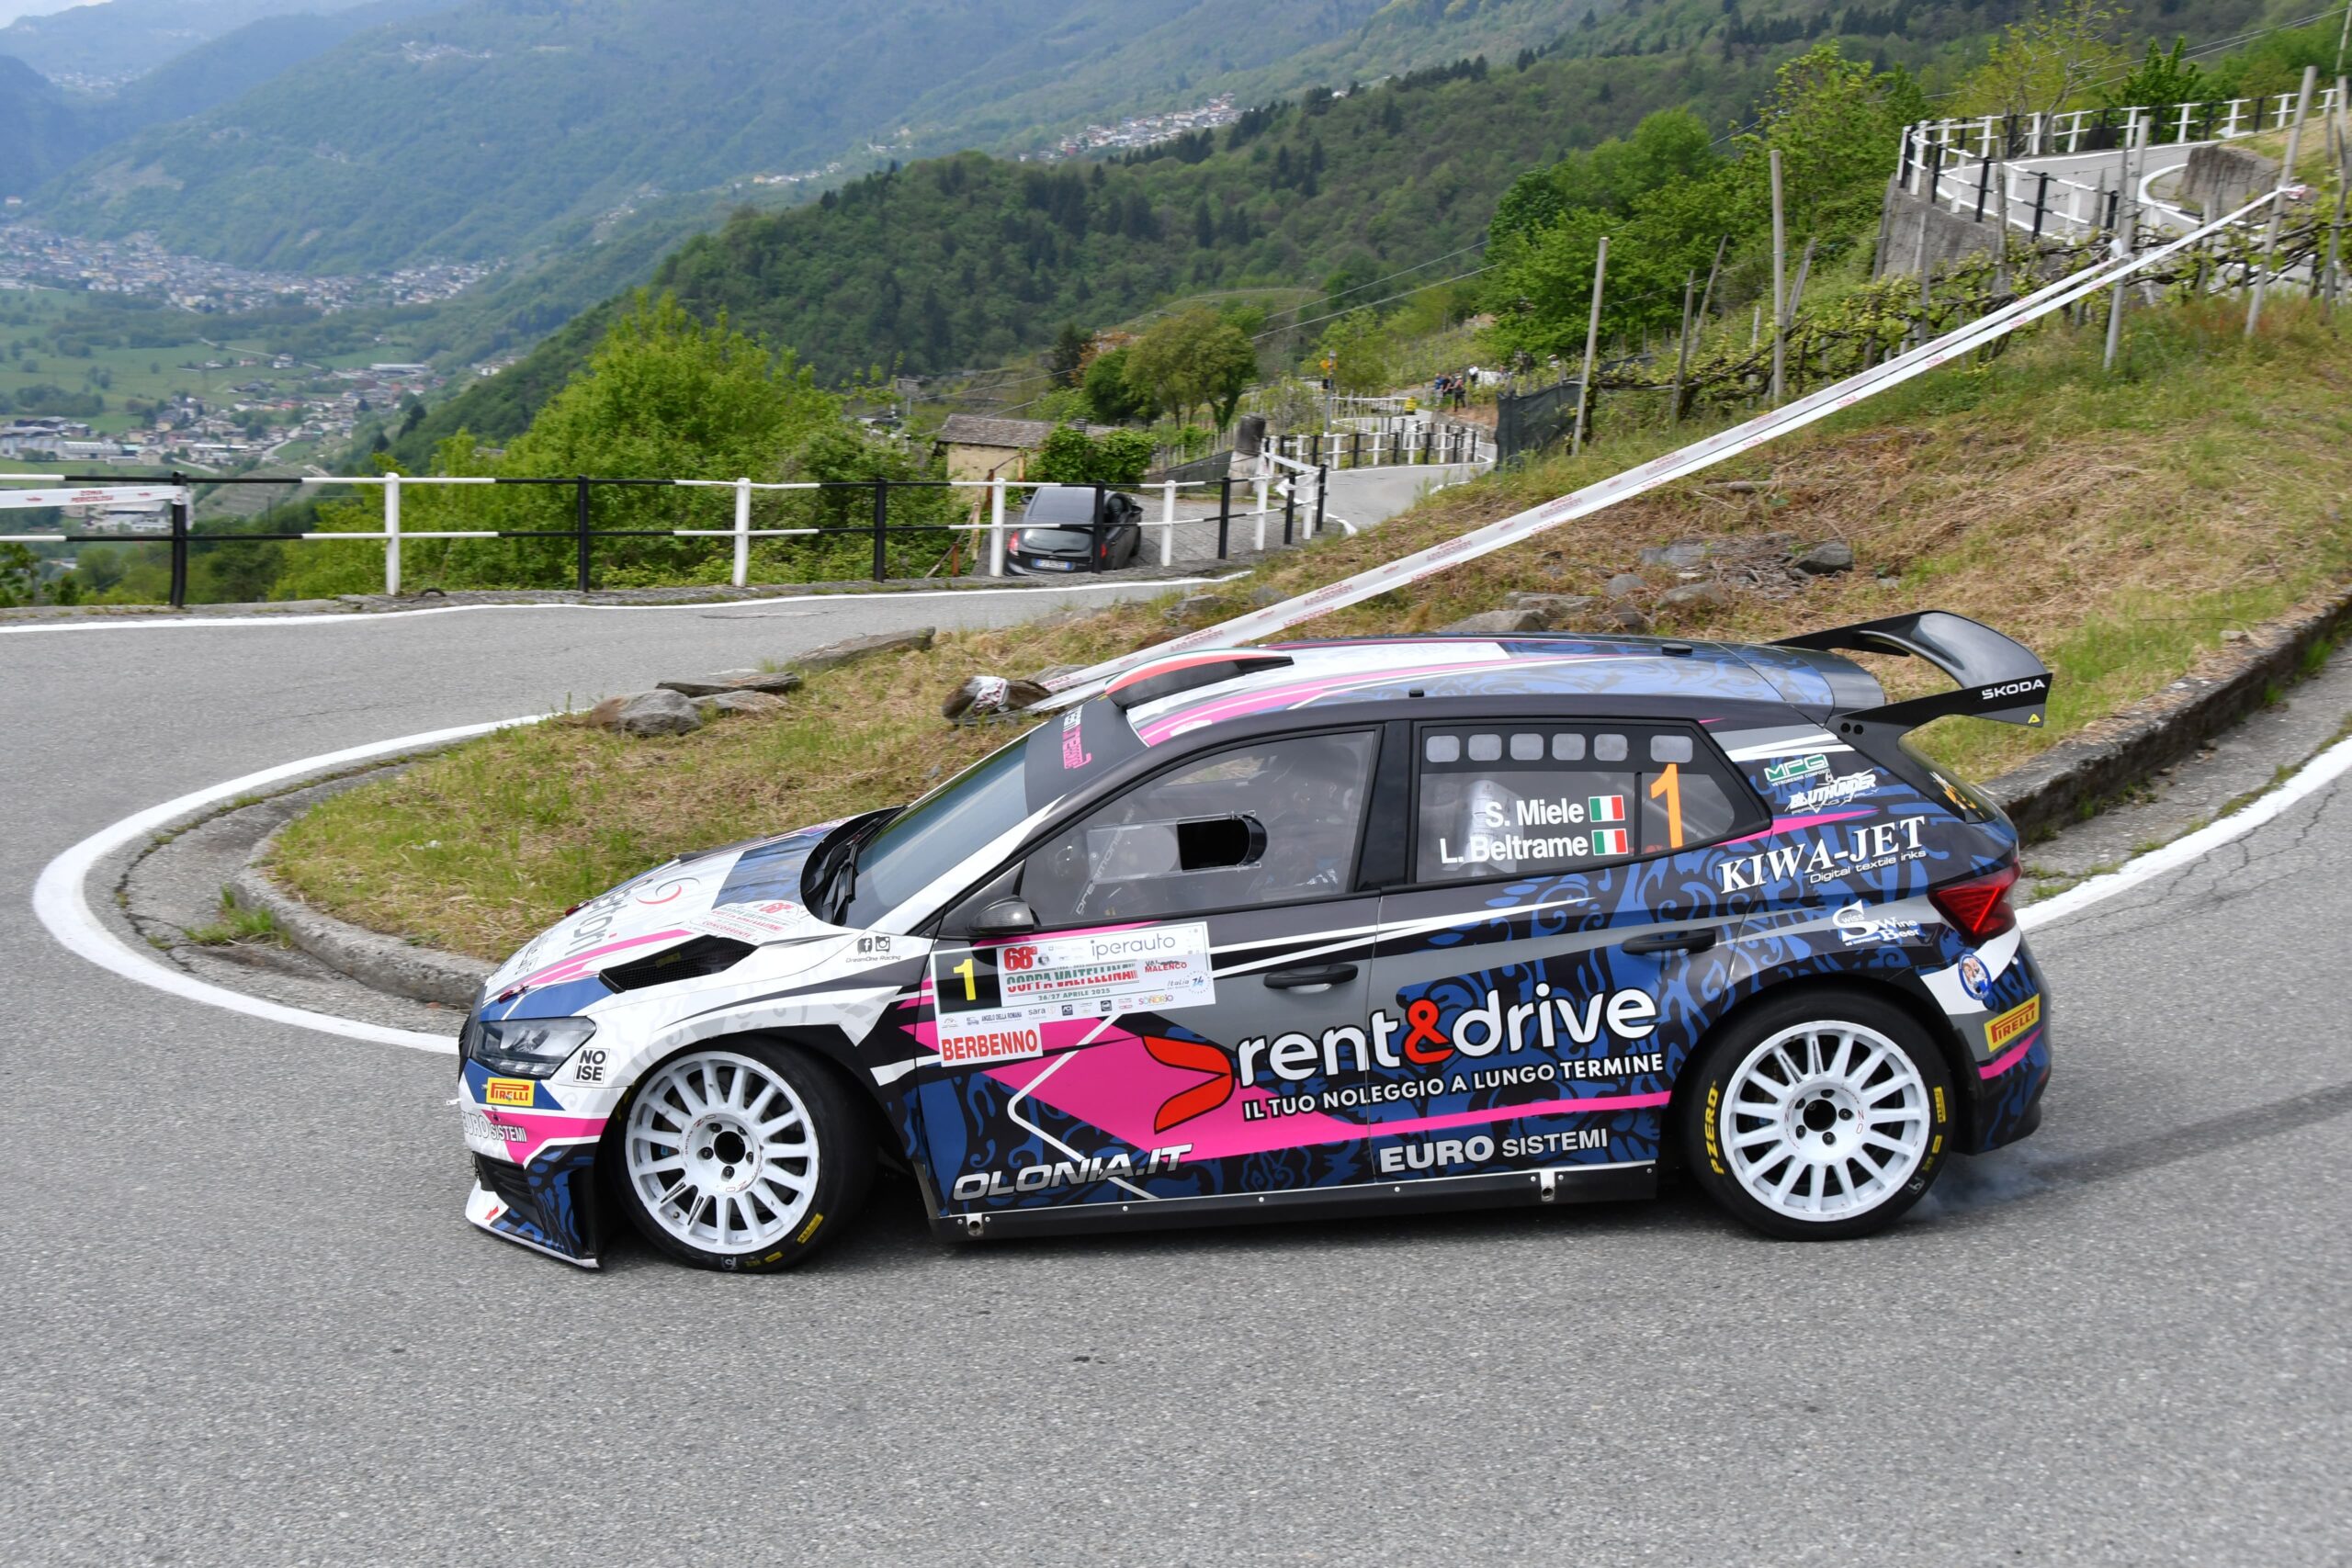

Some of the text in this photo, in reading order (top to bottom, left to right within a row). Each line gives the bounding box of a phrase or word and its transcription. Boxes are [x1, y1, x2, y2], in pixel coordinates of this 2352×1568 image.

[1981, 678, 2046, 700] SKODA
[1764, 753, 1828, 782] MPG
[1485, 796, 1585, 828] S. Miele
[1650, 763, 1683, 849] 1
[1440, 833, 1589, 863] L. Beltrame
[1719, 816, 1926, 894] KIWA-JET
[1809, 849, 1927, 884] Digital textile inks
[1871, 917, 1917, 930] Wine
[1879, 929, 1920, 942] Beer
[1091, 932, 1176, 961] iperauto
[953, 958, 977, 1002] 1
[1145, 962, 1188, 973] MALENCO
[1038, 992, 1060, 1001] 26/27
[1063, 989, 1089, 998] APRILE
[1028, 1008, 1046, 1016] sara
[1990, 1001, 2036, 1044] PIRELLI
[942, 1029, 1038, 1062] BERBENNO
[1238, 982, 1657, 1087] rent&drive
[579, 1050, 606, 1065] NO
[575, 1066, 604, 1081] ISE
[1244, 1054, 1664, 1119] IL TUO NOLEGGIO A LUNGO TERMINE
[490, 1082, 530, 1101] PIRELLI
[490, 1124, 527, 1143] SISTEMI
[1379, 1128, 1608, 1175] EURO SISTEMI
[953, 1143, 1193, 1201] OLONIA.IT
